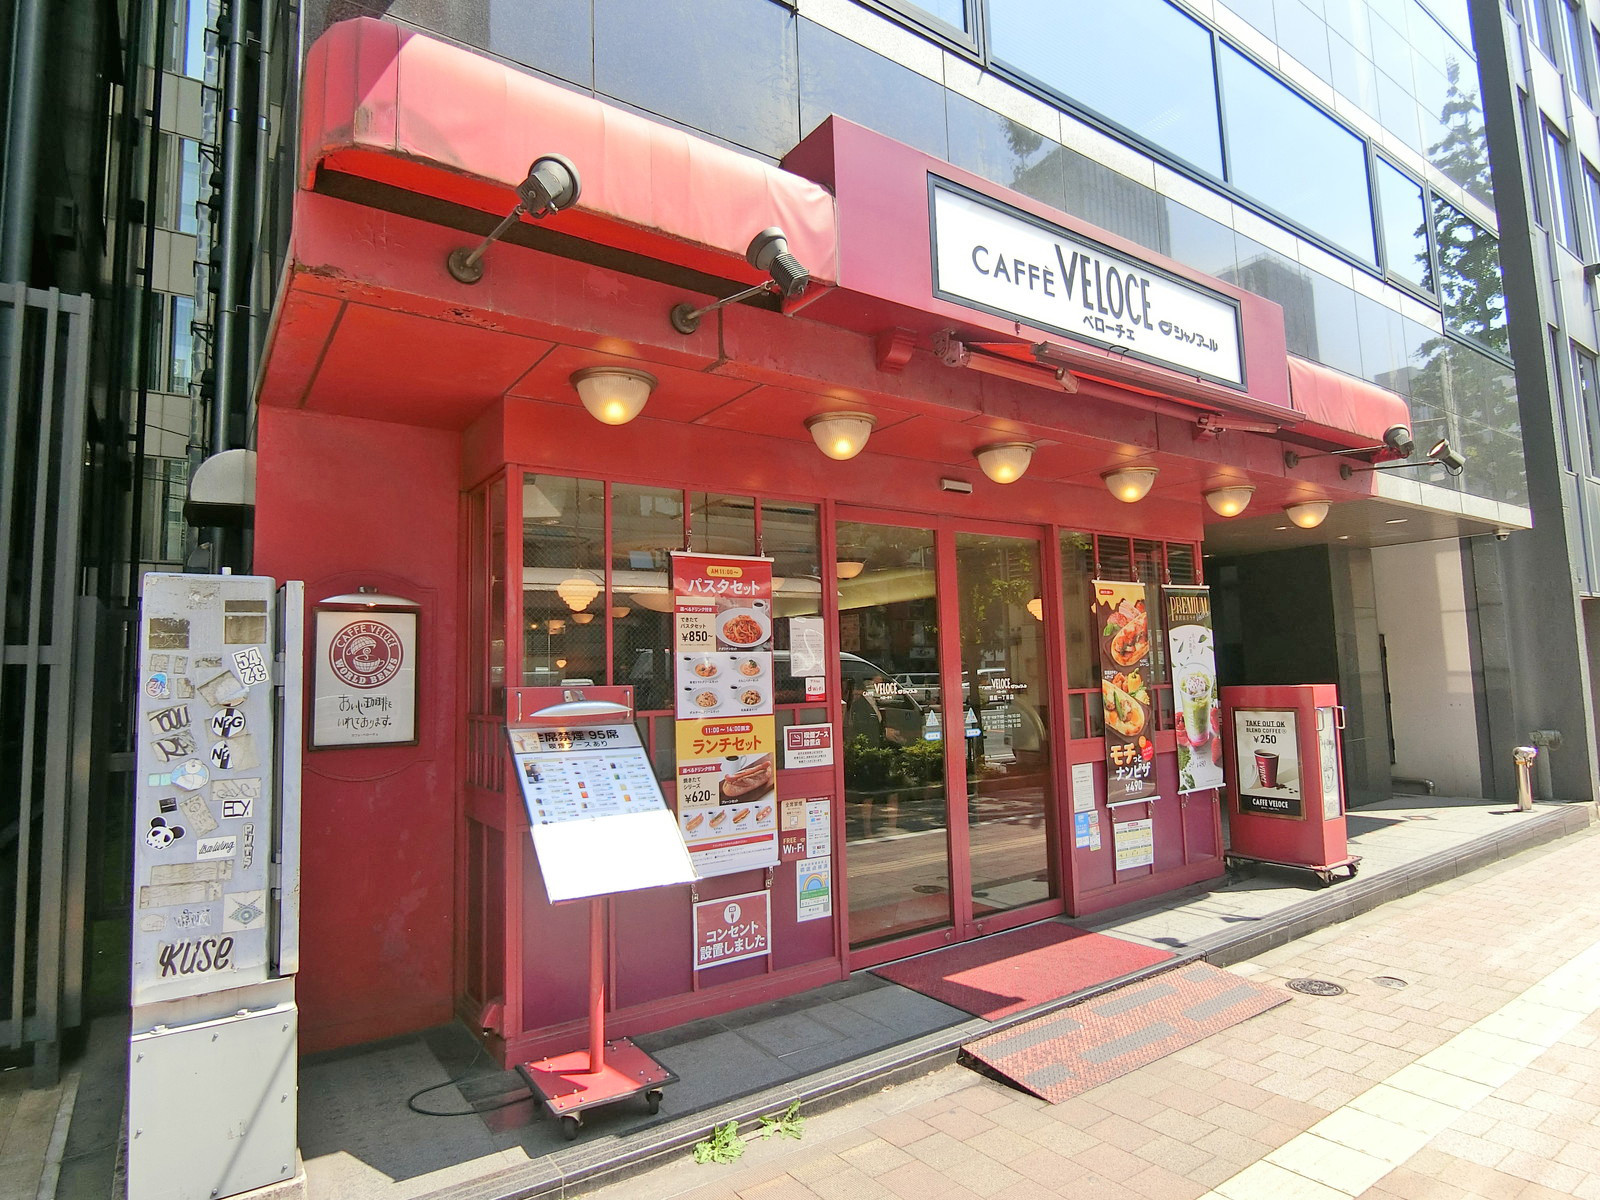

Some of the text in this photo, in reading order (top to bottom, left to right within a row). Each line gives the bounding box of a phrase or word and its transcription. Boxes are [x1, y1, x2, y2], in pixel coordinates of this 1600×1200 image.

[972, 244, 1153, 330] CAFFÈ VELOCE
[1083, 315, 1135, 341] ベローチェ
[1173, 325, 1218, 352] シャノアール
[688, 578, 760, 595] パスタセット
[1169, 596, 1208, 621] PREMIUM
[370, 624, 397, 648] VELOCE
[335, 658, 398, 684] WORLD BEANS
[874, 683, 897, 694] VELOCE
[991, 678, 1010, 689] VELOCE
[588, 729, 619, 740] 95席
[693, 735, 761, 754] ランチセット
[1116, 761, 1151, 781] ナンピザ
[1125, 780, 1143, 792] ¥490
[1268, 799, 1288, 809] VELOCE
[706, 921, 759, 943] コンセント
[700, 934, 765, 961] 設置しました
